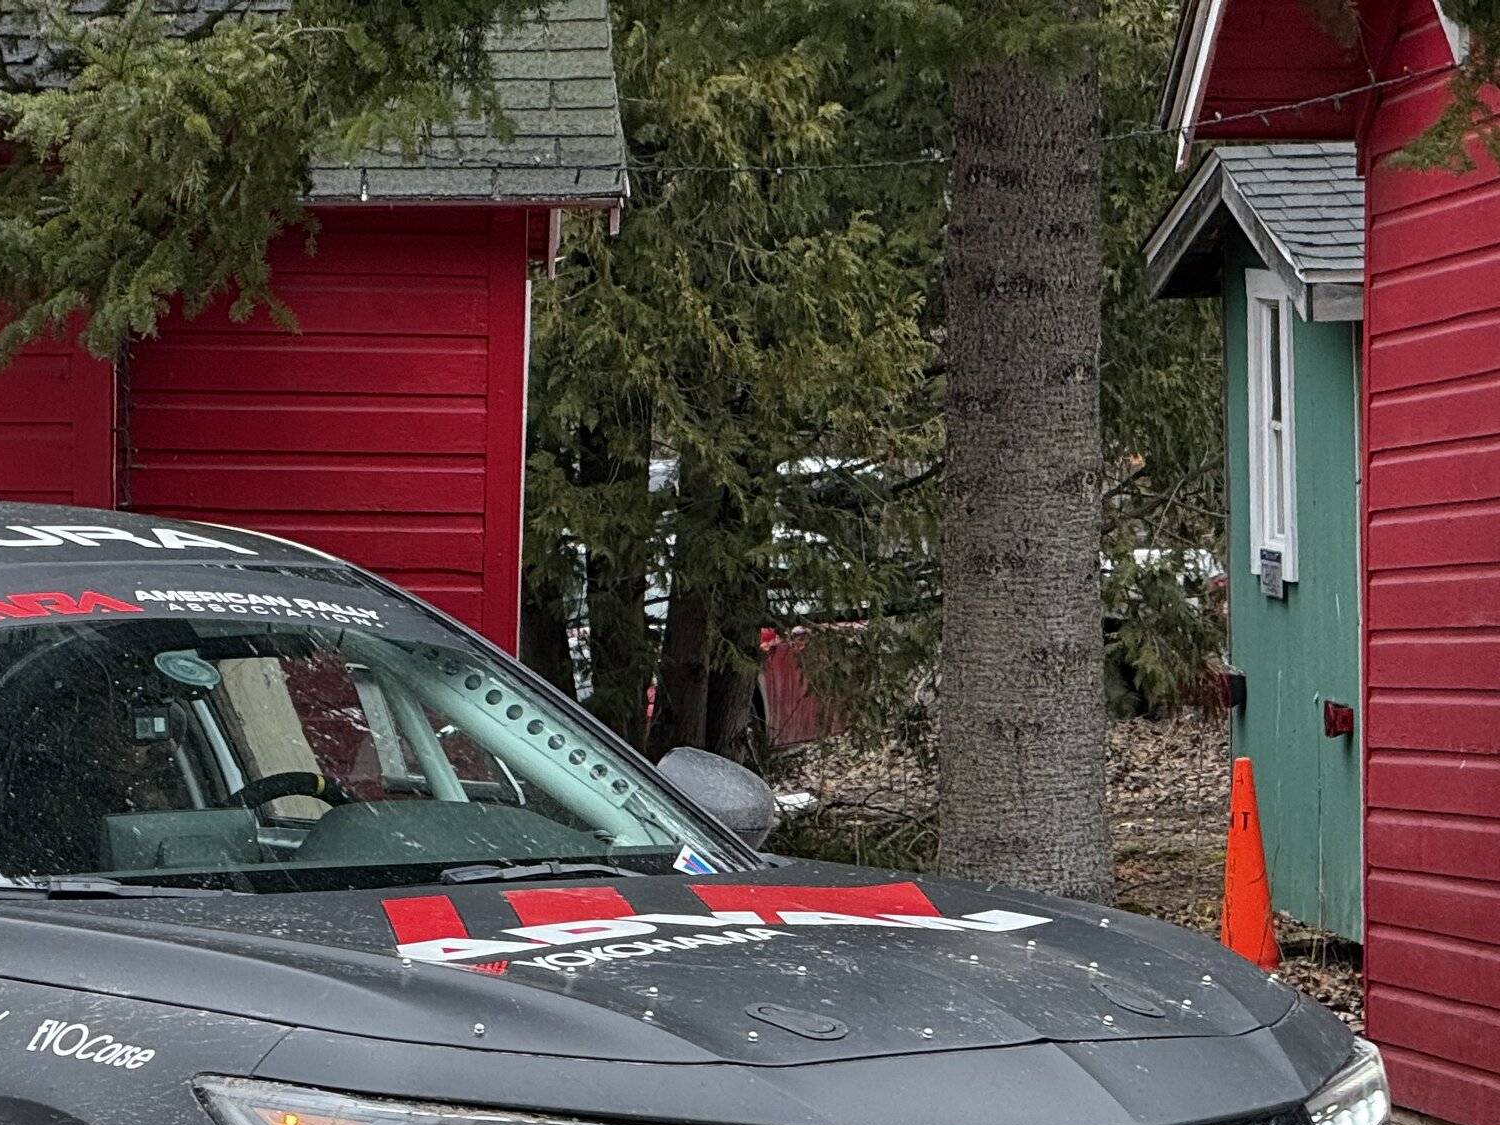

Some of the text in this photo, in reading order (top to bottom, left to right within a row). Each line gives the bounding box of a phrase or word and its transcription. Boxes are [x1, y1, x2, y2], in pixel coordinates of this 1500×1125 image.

[133, 590, 381, 621] AMERICAN RALLY
[396, 910, 1053, 963] ADVAN
[512, 925, 800, 972] YOKOHAMA
